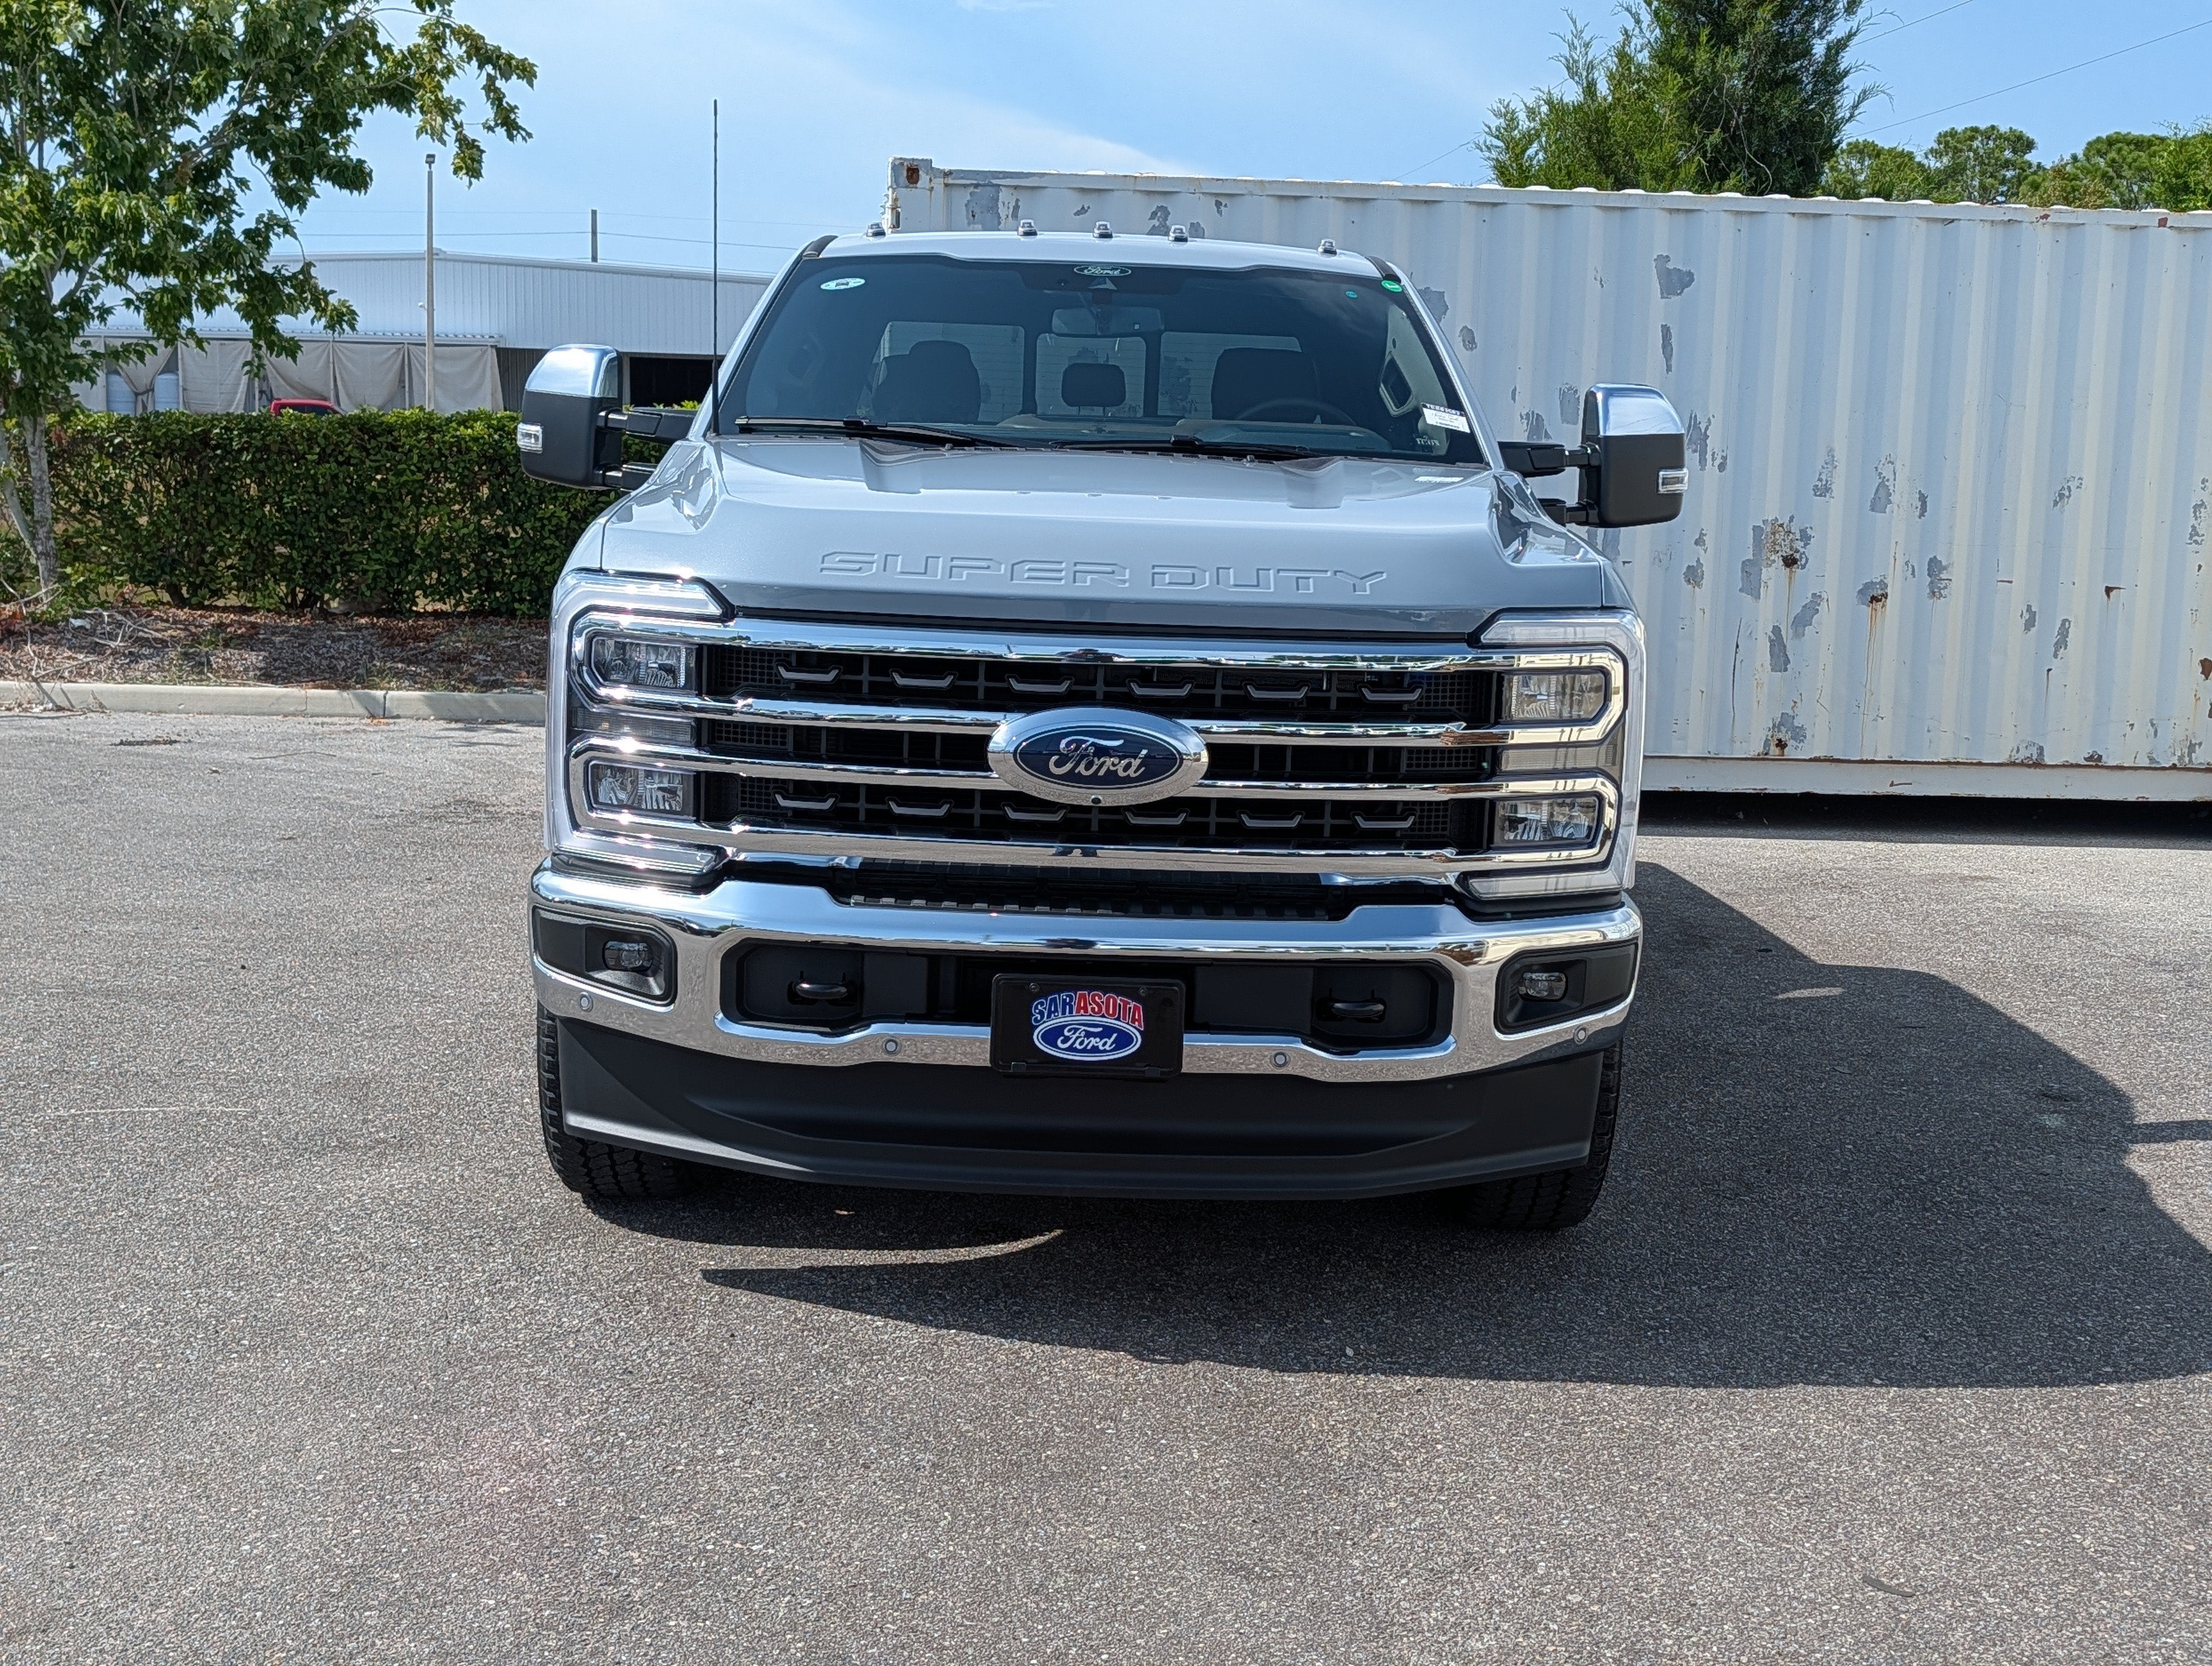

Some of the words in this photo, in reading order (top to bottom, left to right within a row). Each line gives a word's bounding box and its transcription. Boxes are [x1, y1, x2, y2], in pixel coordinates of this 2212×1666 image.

[1084, 265, 1121, 274] Ford
[819, 551, 1129, 587] SUPER
[1151, 565, 1387, 594] DUTY
[1049, 735, 1148, 778] Ford
[1032, 991, 1144, 1030] SARASOTA
[1057, 1025, 1116, 1050] Ford
